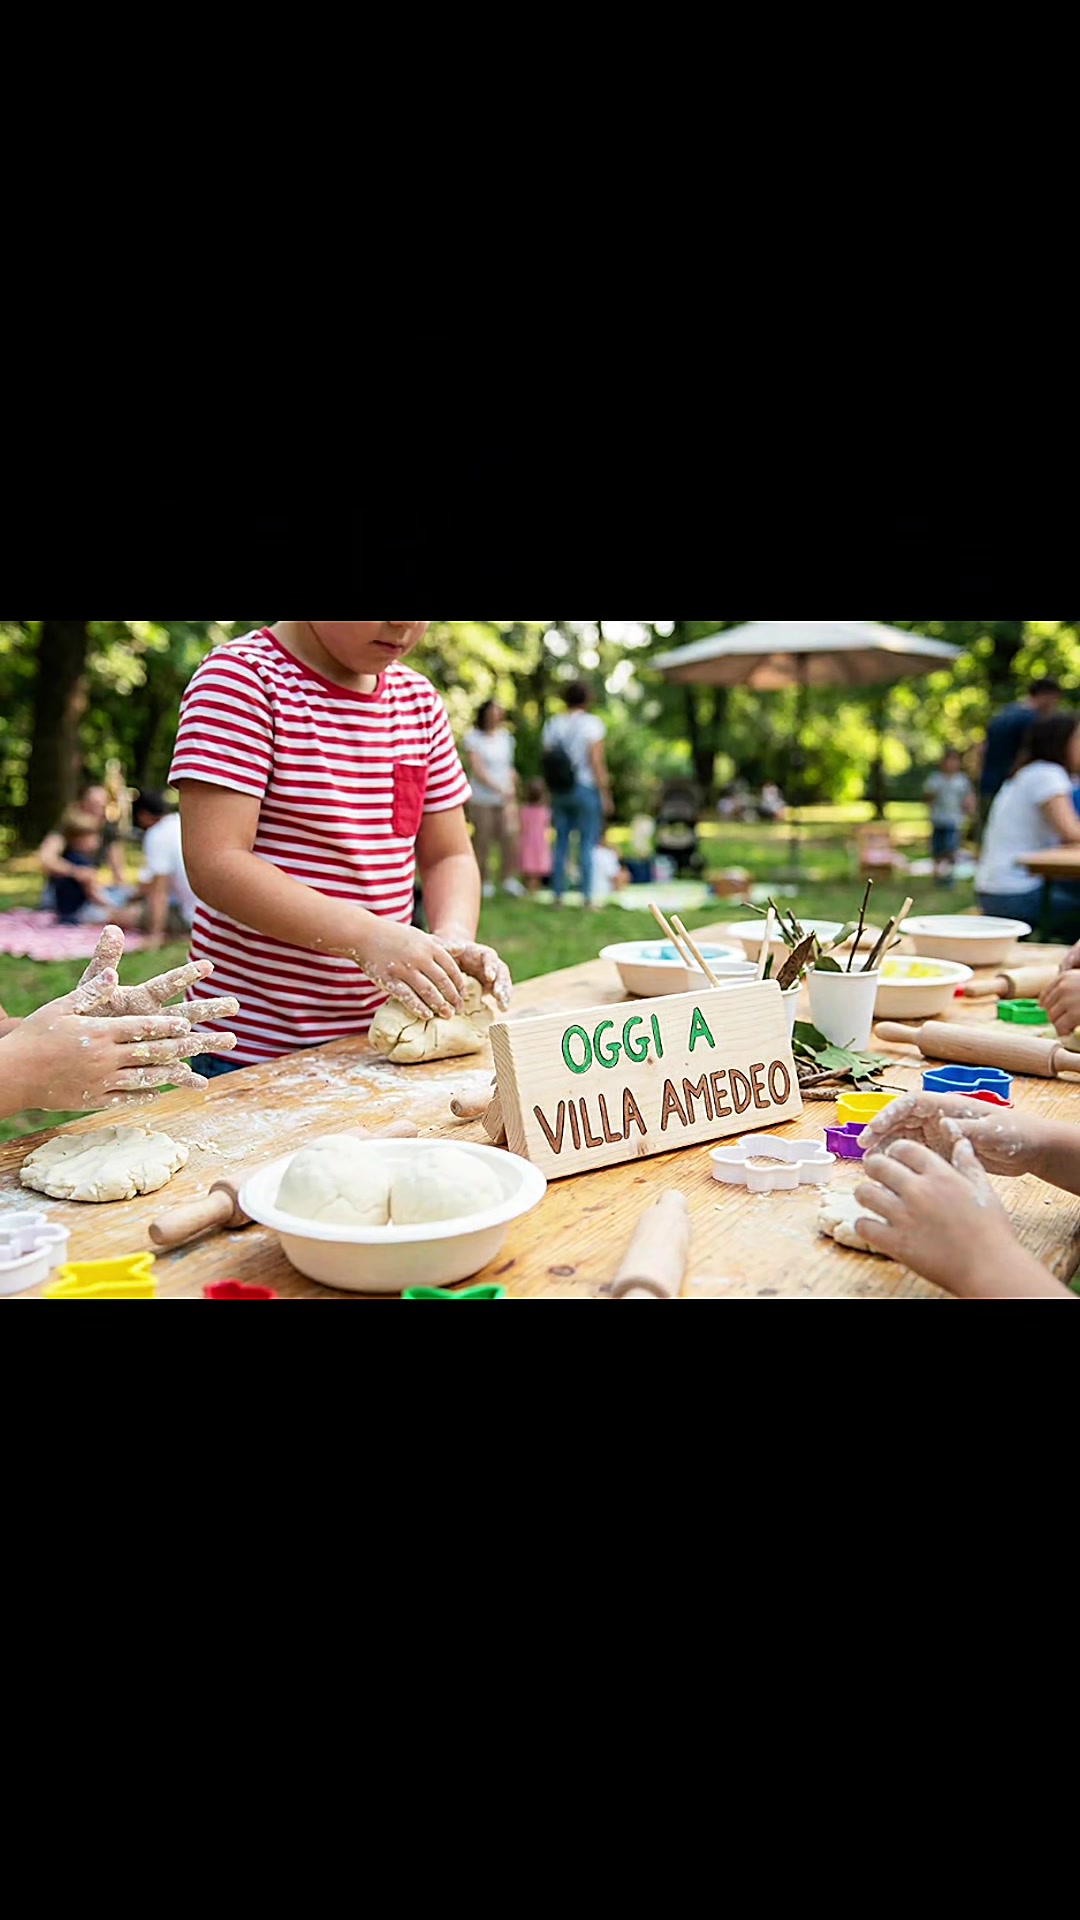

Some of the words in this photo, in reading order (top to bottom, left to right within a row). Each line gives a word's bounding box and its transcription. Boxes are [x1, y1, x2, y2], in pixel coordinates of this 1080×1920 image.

[561, 1013, 664, 1075] OGGI
[688, 1006, 716, 1052] A
[533, 1087, 648, 1155] VILLA
[660, 1060, 791, 1131] AMEDEO
